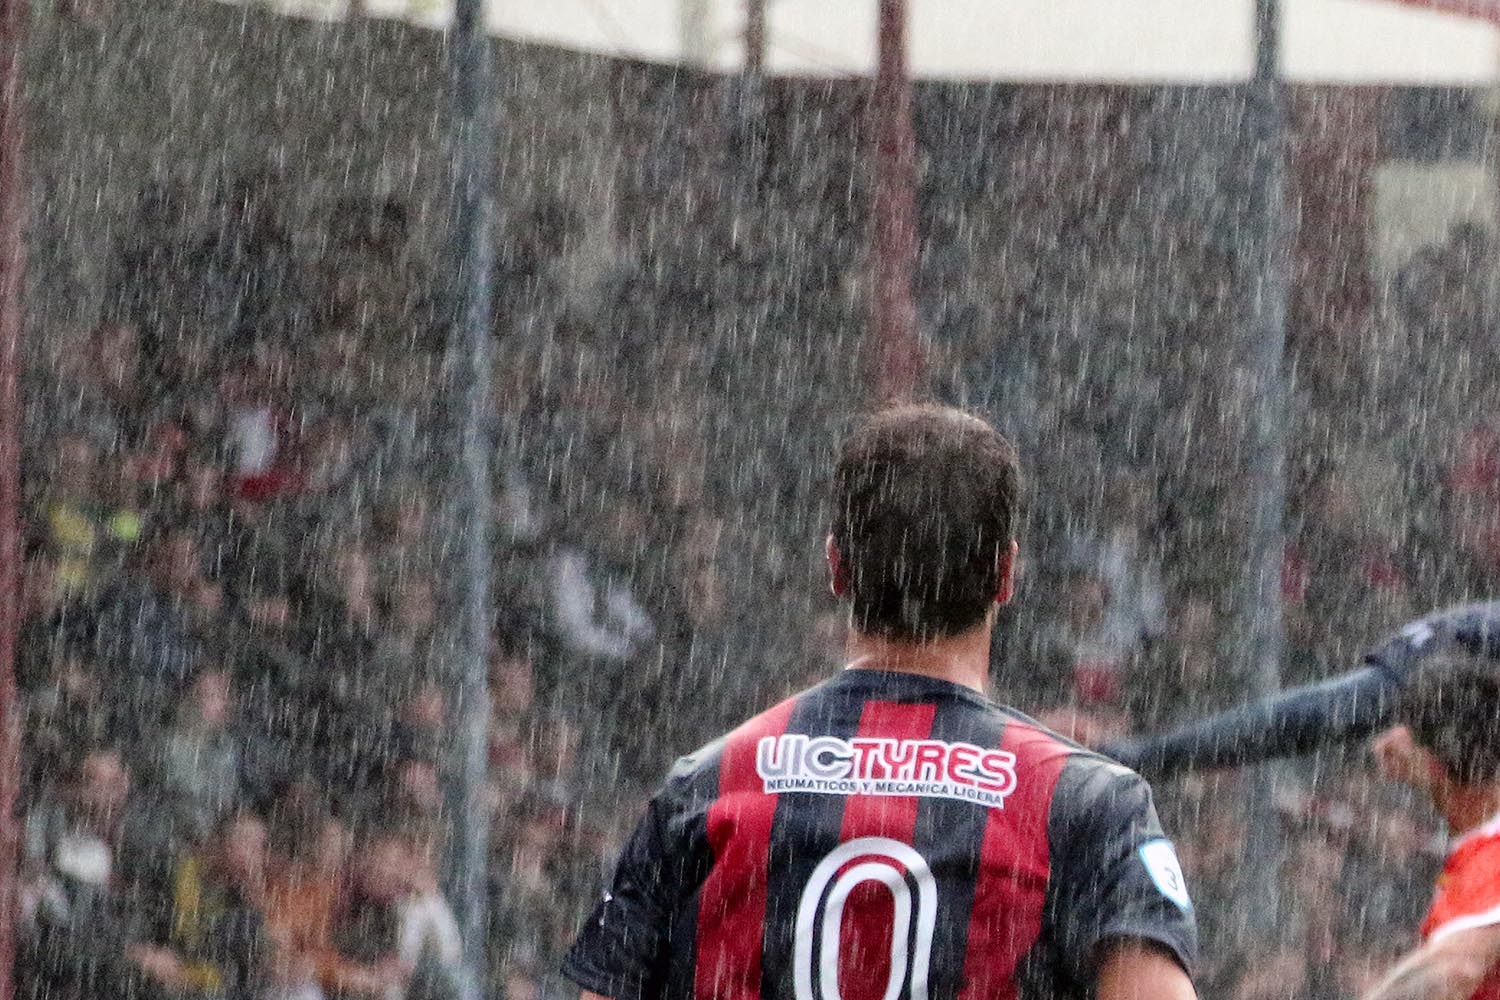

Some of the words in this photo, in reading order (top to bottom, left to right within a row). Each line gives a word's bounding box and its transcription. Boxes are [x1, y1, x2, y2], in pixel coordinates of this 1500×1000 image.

[767, 778, 857, 793] NEUMATICOS
[862, 780, 871, 792] Y
[875, 781, 949, 796] MECANICA
[953, 785, 1002, 805] LIGERA
[1163, 866, 1180, 892] 3
